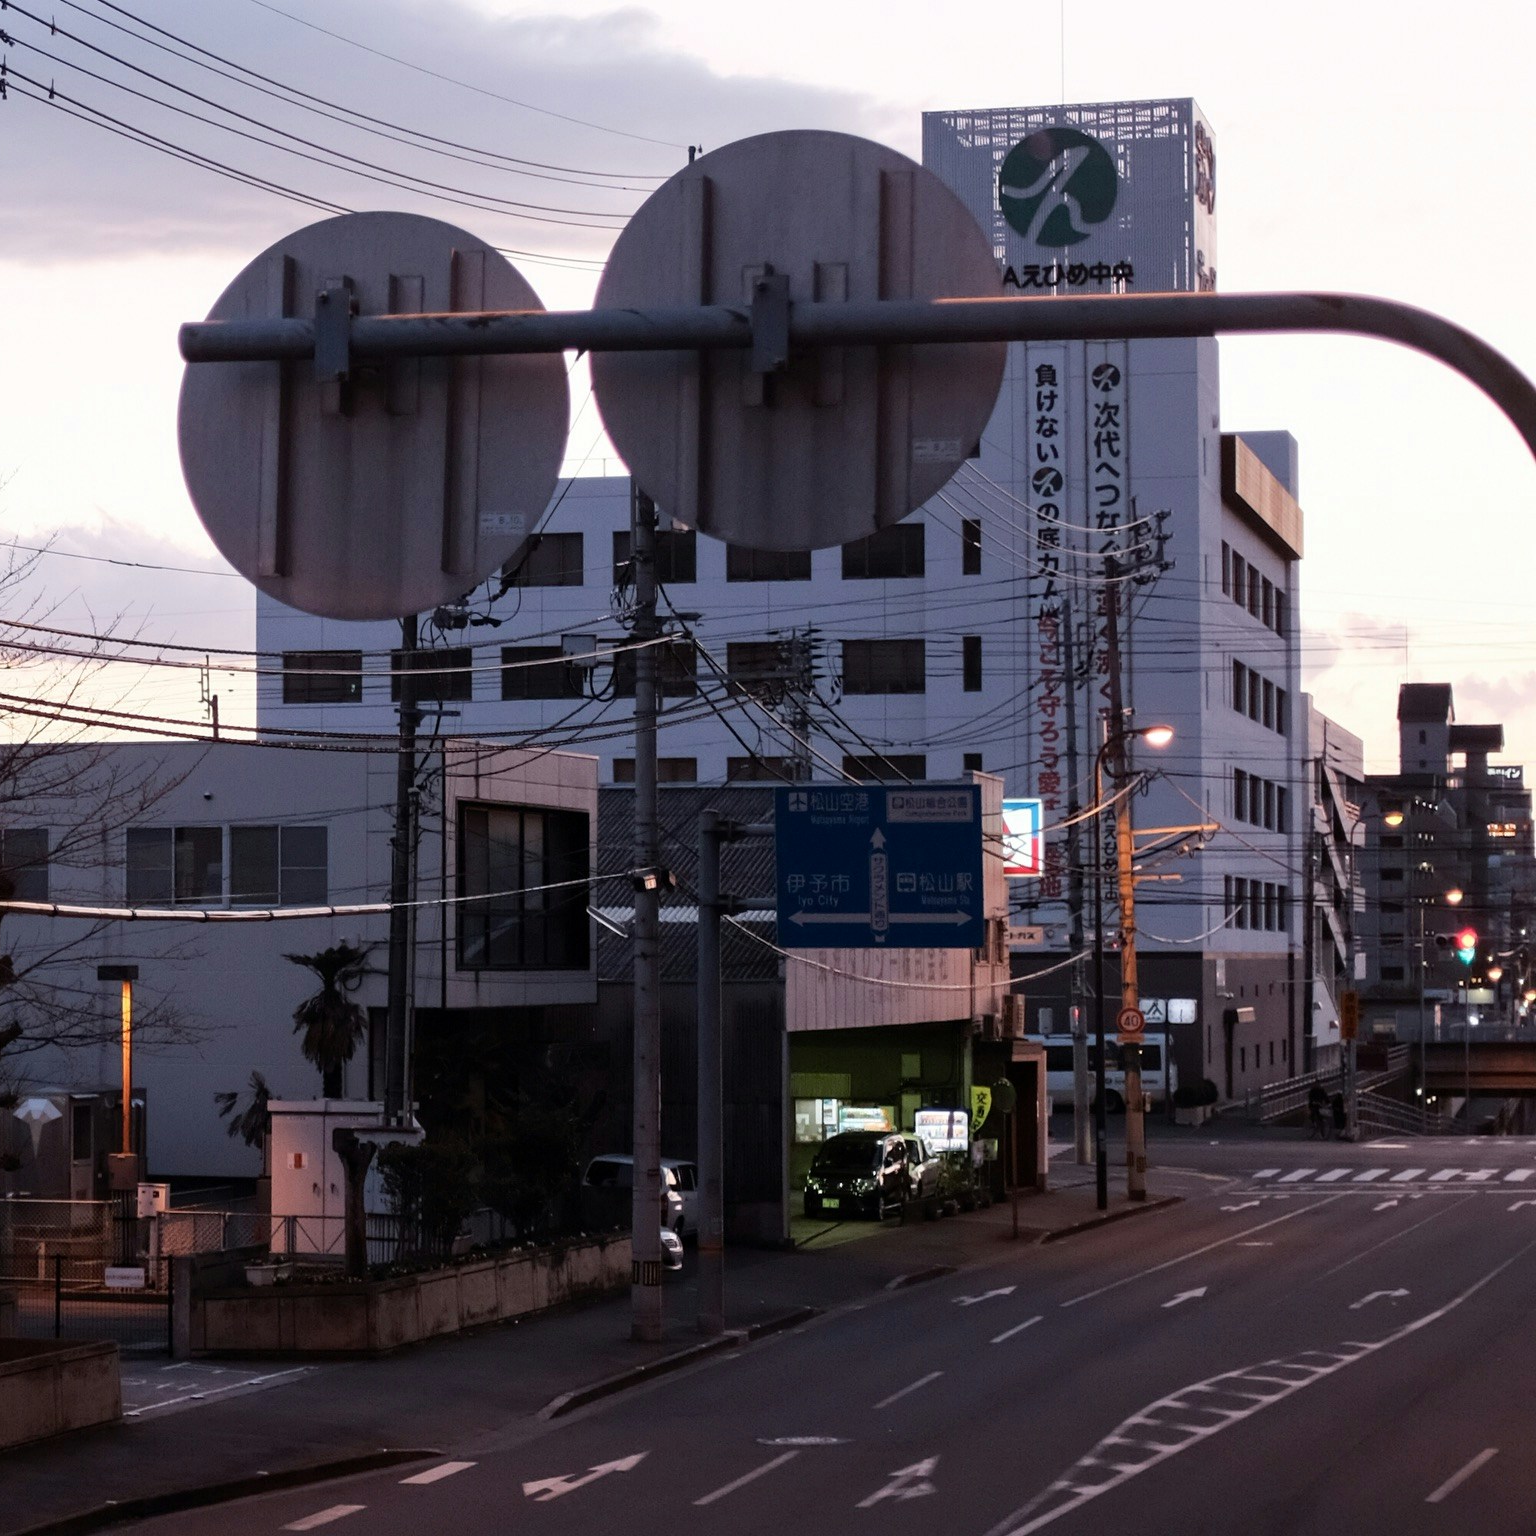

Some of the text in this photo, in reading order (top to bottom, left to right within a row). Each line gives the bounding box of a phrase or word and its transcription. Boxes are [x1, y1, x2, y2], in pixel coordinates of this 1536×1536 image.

[1003, 260, 1135, 289] Aえひめ中央
[810, 791, 870, 812] 松山空港
[785, 873, 851, 894] 伊予市
[919, 872, 974, 893] 松山駅
[798, 894, 839, 907] Iyo City
[1123, 1015, 1139, 1027] 40
